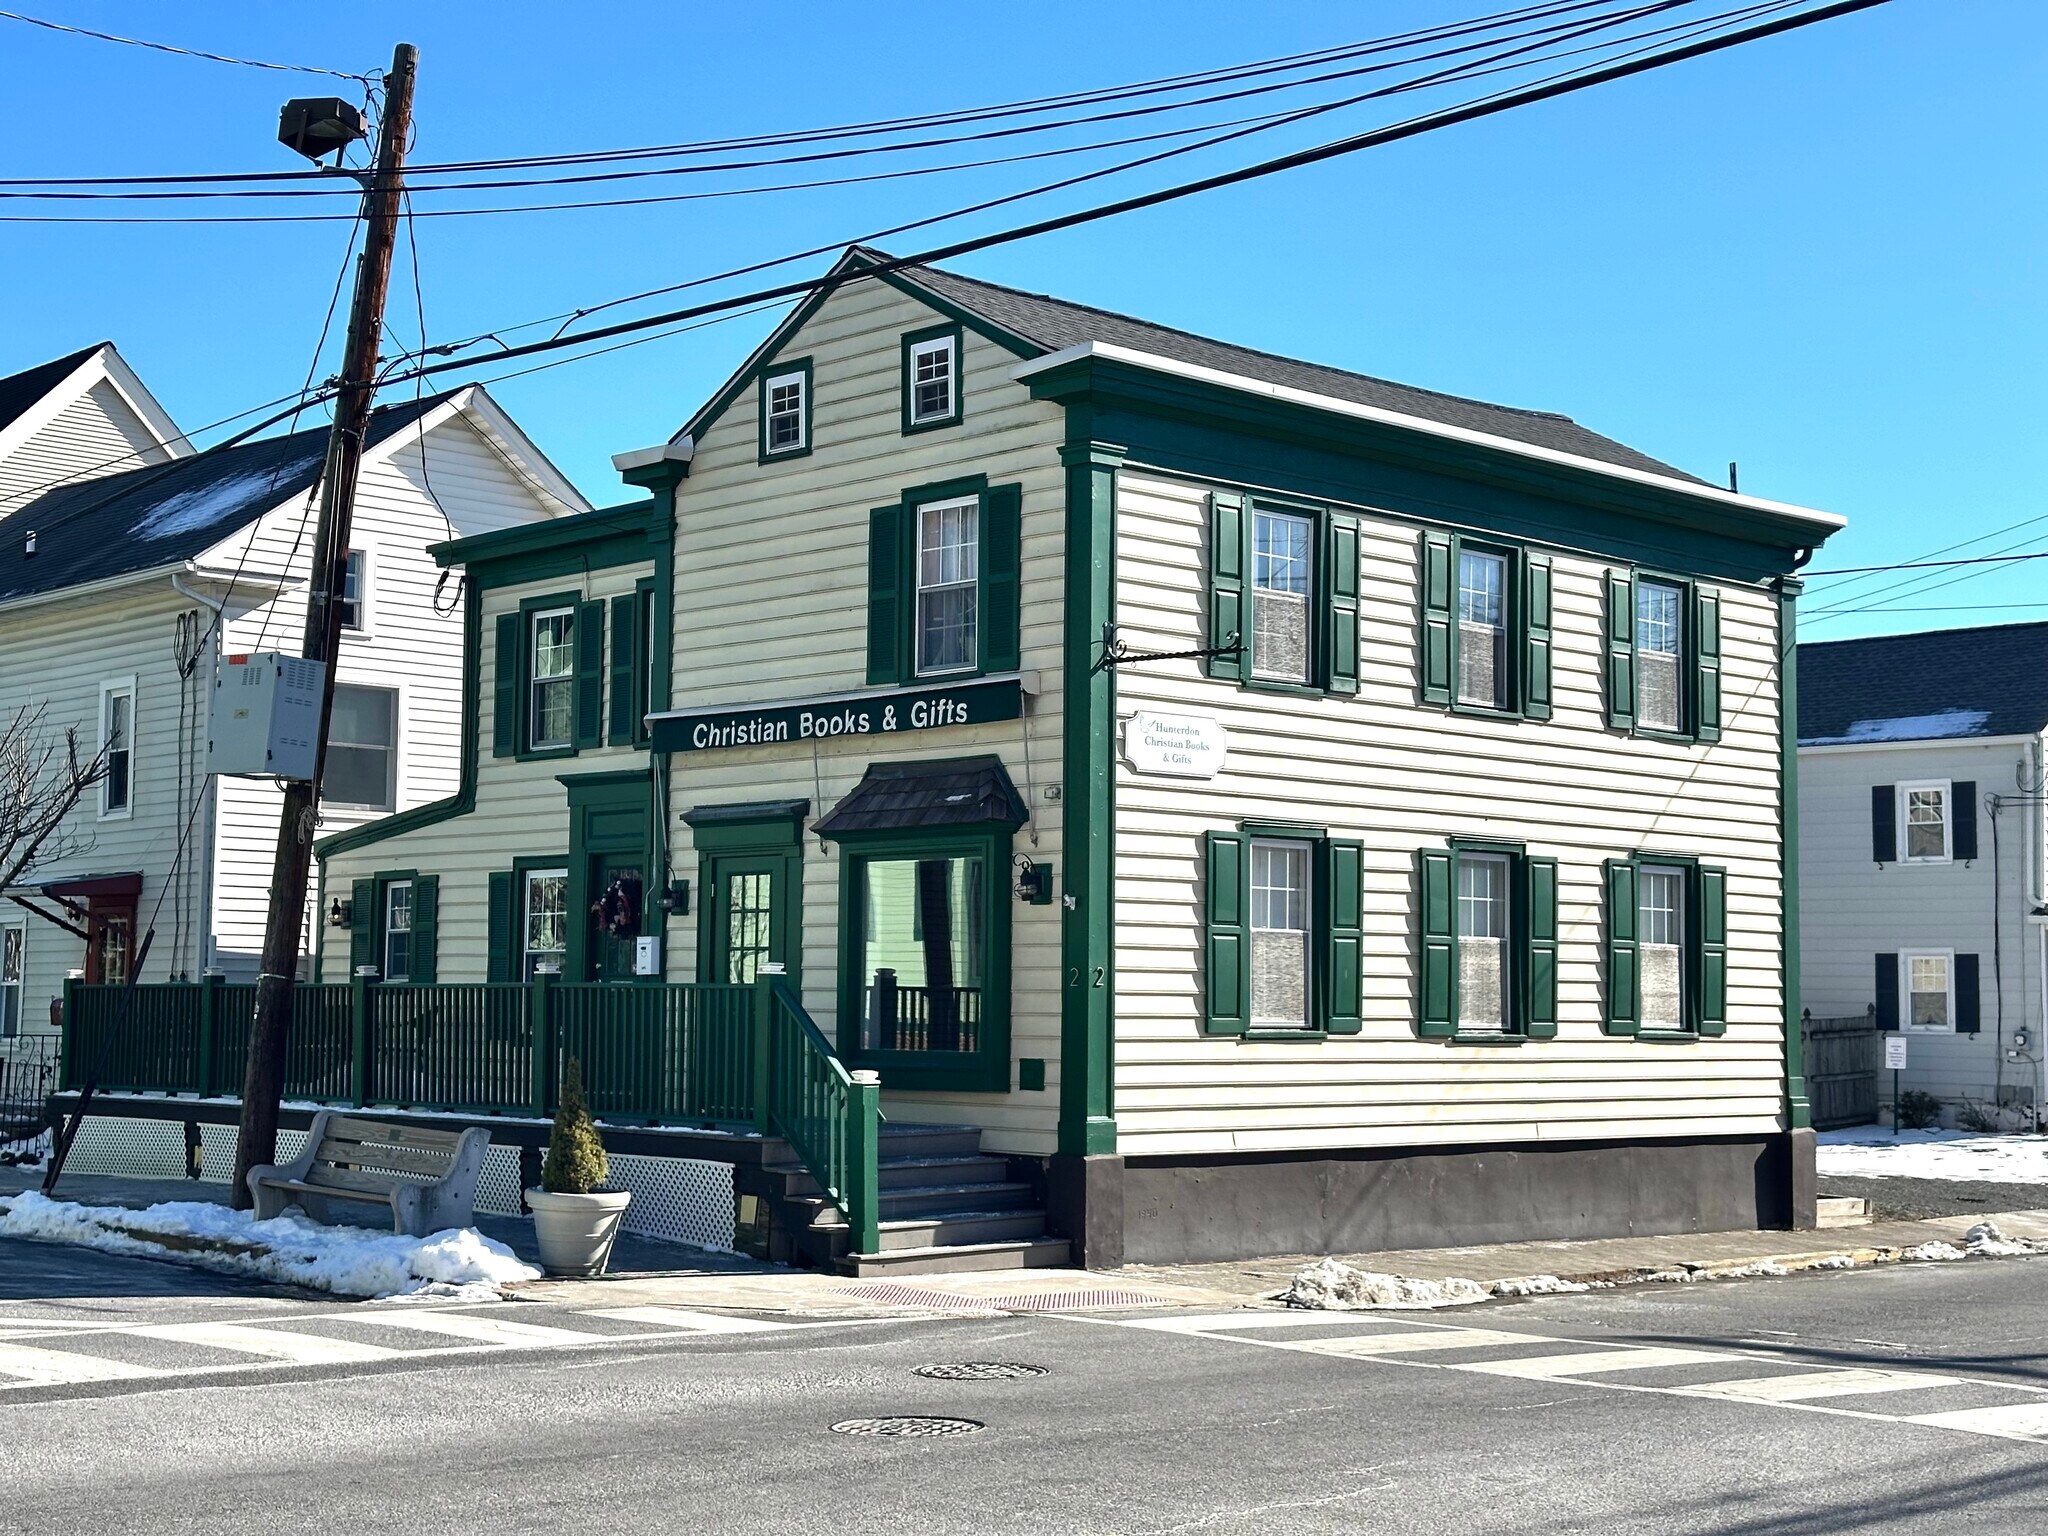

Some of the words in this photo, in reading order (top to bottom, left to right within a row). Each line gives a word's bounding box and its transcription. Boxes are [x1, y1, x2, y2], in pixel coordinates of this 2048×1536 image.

[692, 717, 788, 749] Christian
[799, 708, 871, 738] Books
[882, 704, 897, 731] &
[910, 698, 968, 728] Gifts
[1155, 722, 1200, 736] Hunterdon
[1144, 735, 1184, 749] Christian
[1185, 739, 1210, 751] Books
[1162, 752, 1170, 763] &
[1171, 753, 1192, 765] Gifts
